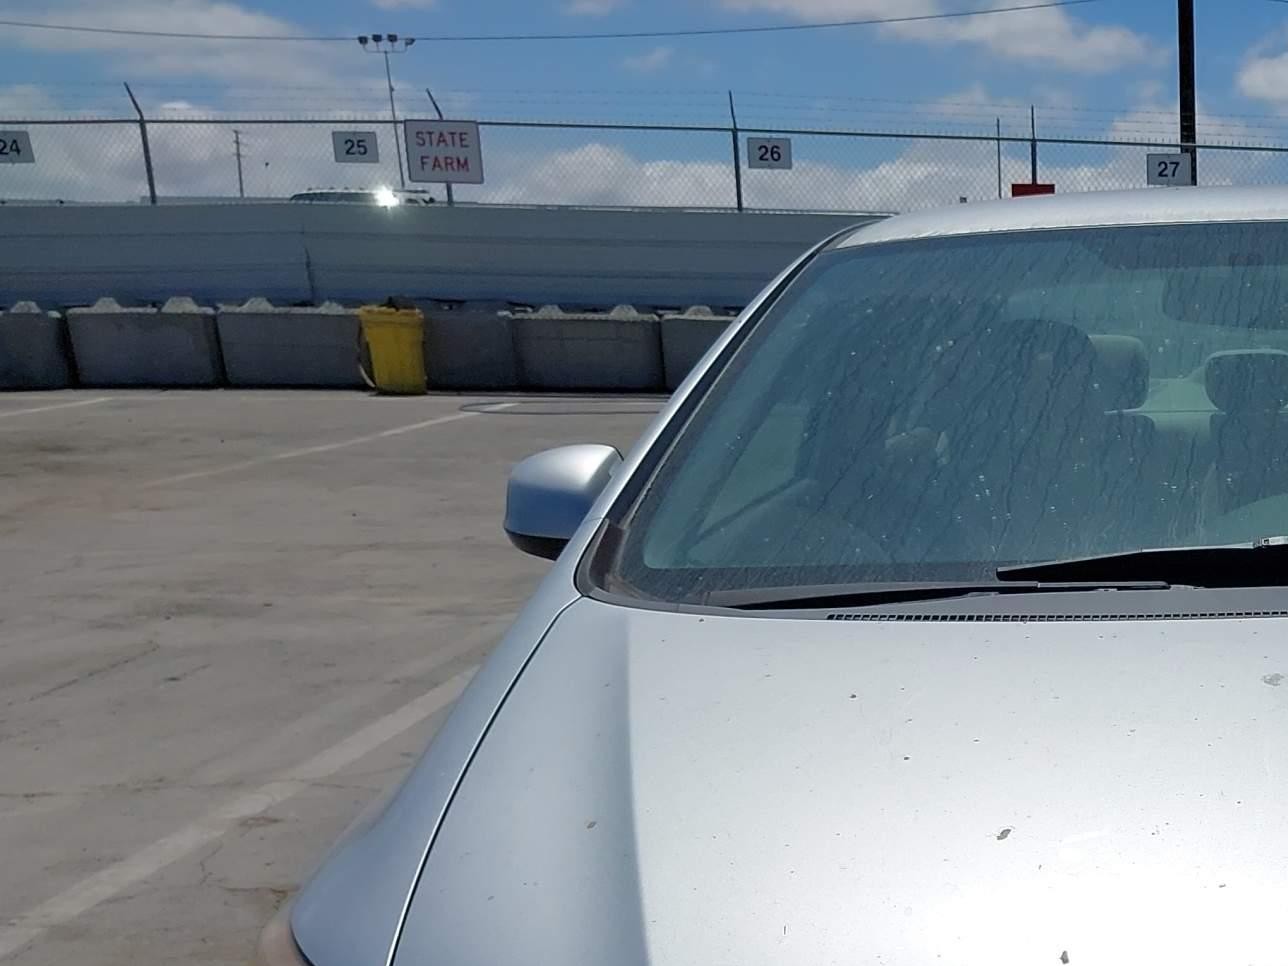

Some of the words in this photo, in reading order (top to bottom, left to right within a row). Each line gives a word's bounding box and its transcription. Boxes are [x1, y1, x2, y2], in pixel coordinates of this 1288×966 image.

[0, 139, 20, 156] 24
[344, 139, 368, 156] 25
[415, 131, 469, 148] STATE
[758, 145, 781, 161] 26
[420, 156, 469, 172] FARM
[1157, 161, 1180, 178] 27
